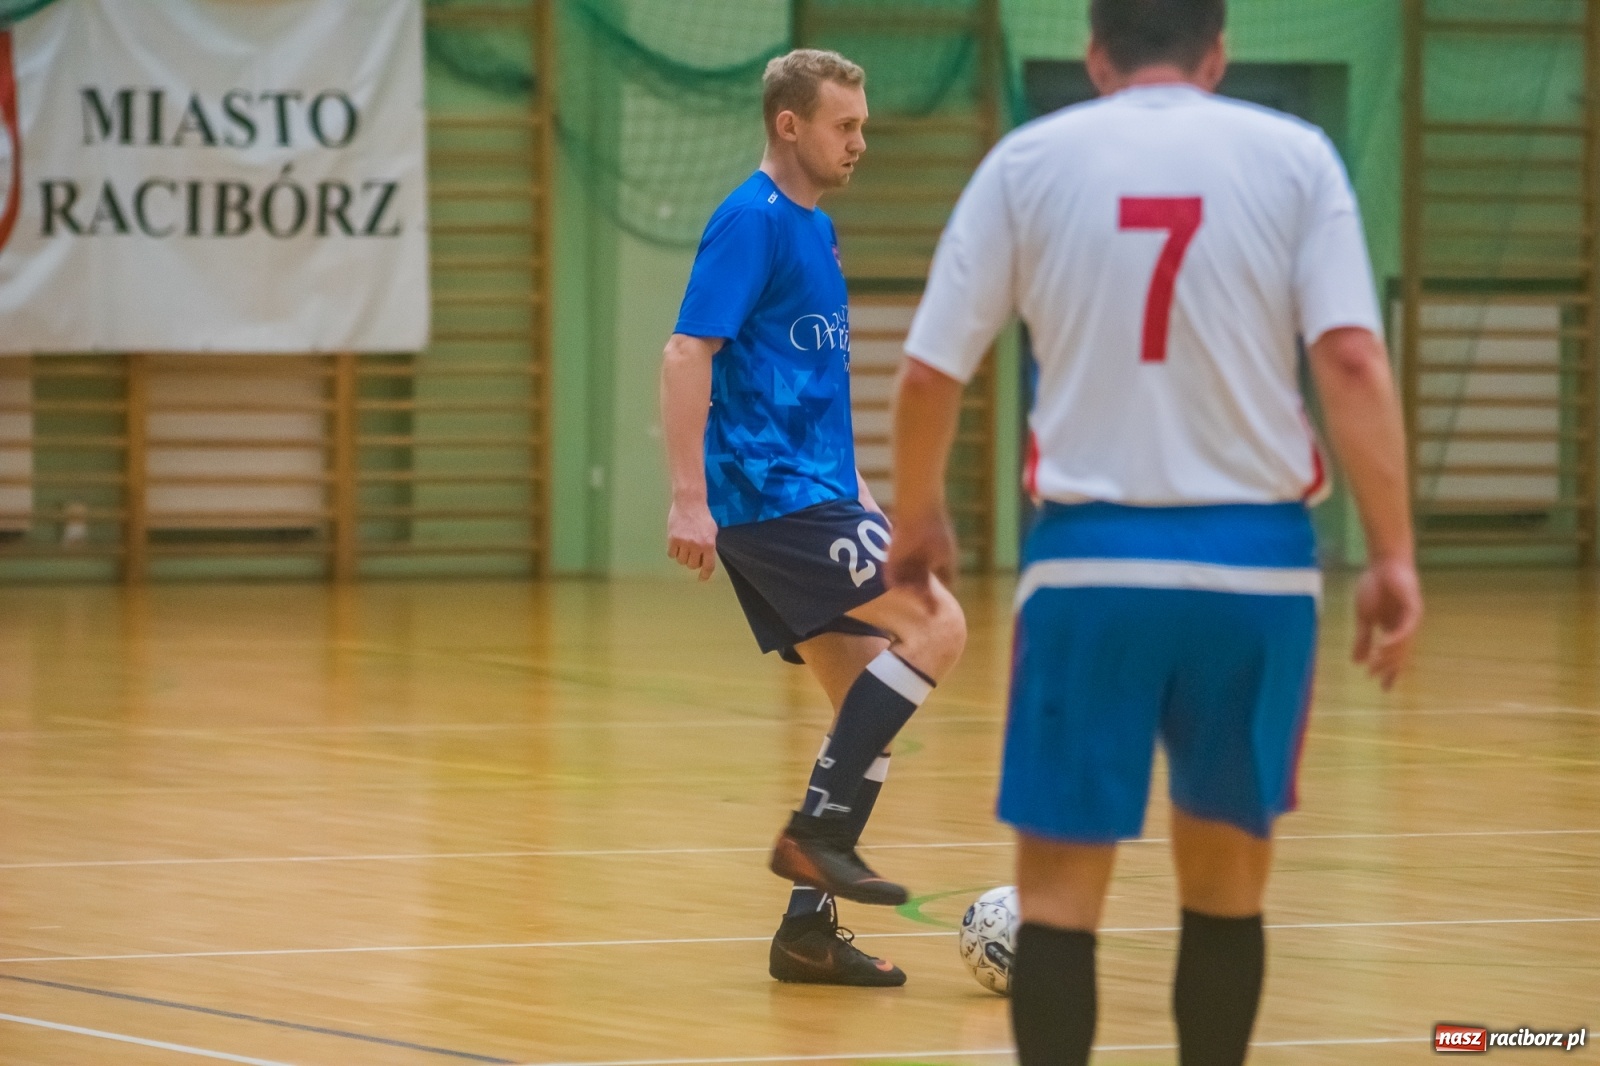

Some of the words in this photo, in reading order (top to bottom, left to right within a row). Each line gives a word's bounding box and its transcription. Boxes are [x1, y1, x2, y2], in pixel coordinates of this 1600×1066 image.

[80, 86, 360, 148] MIASTO
[38, 163, 402, 239] RACIBÓRZ
[1118, 196, 1204, 363] 7
[829, 519, 892, 588] 20
